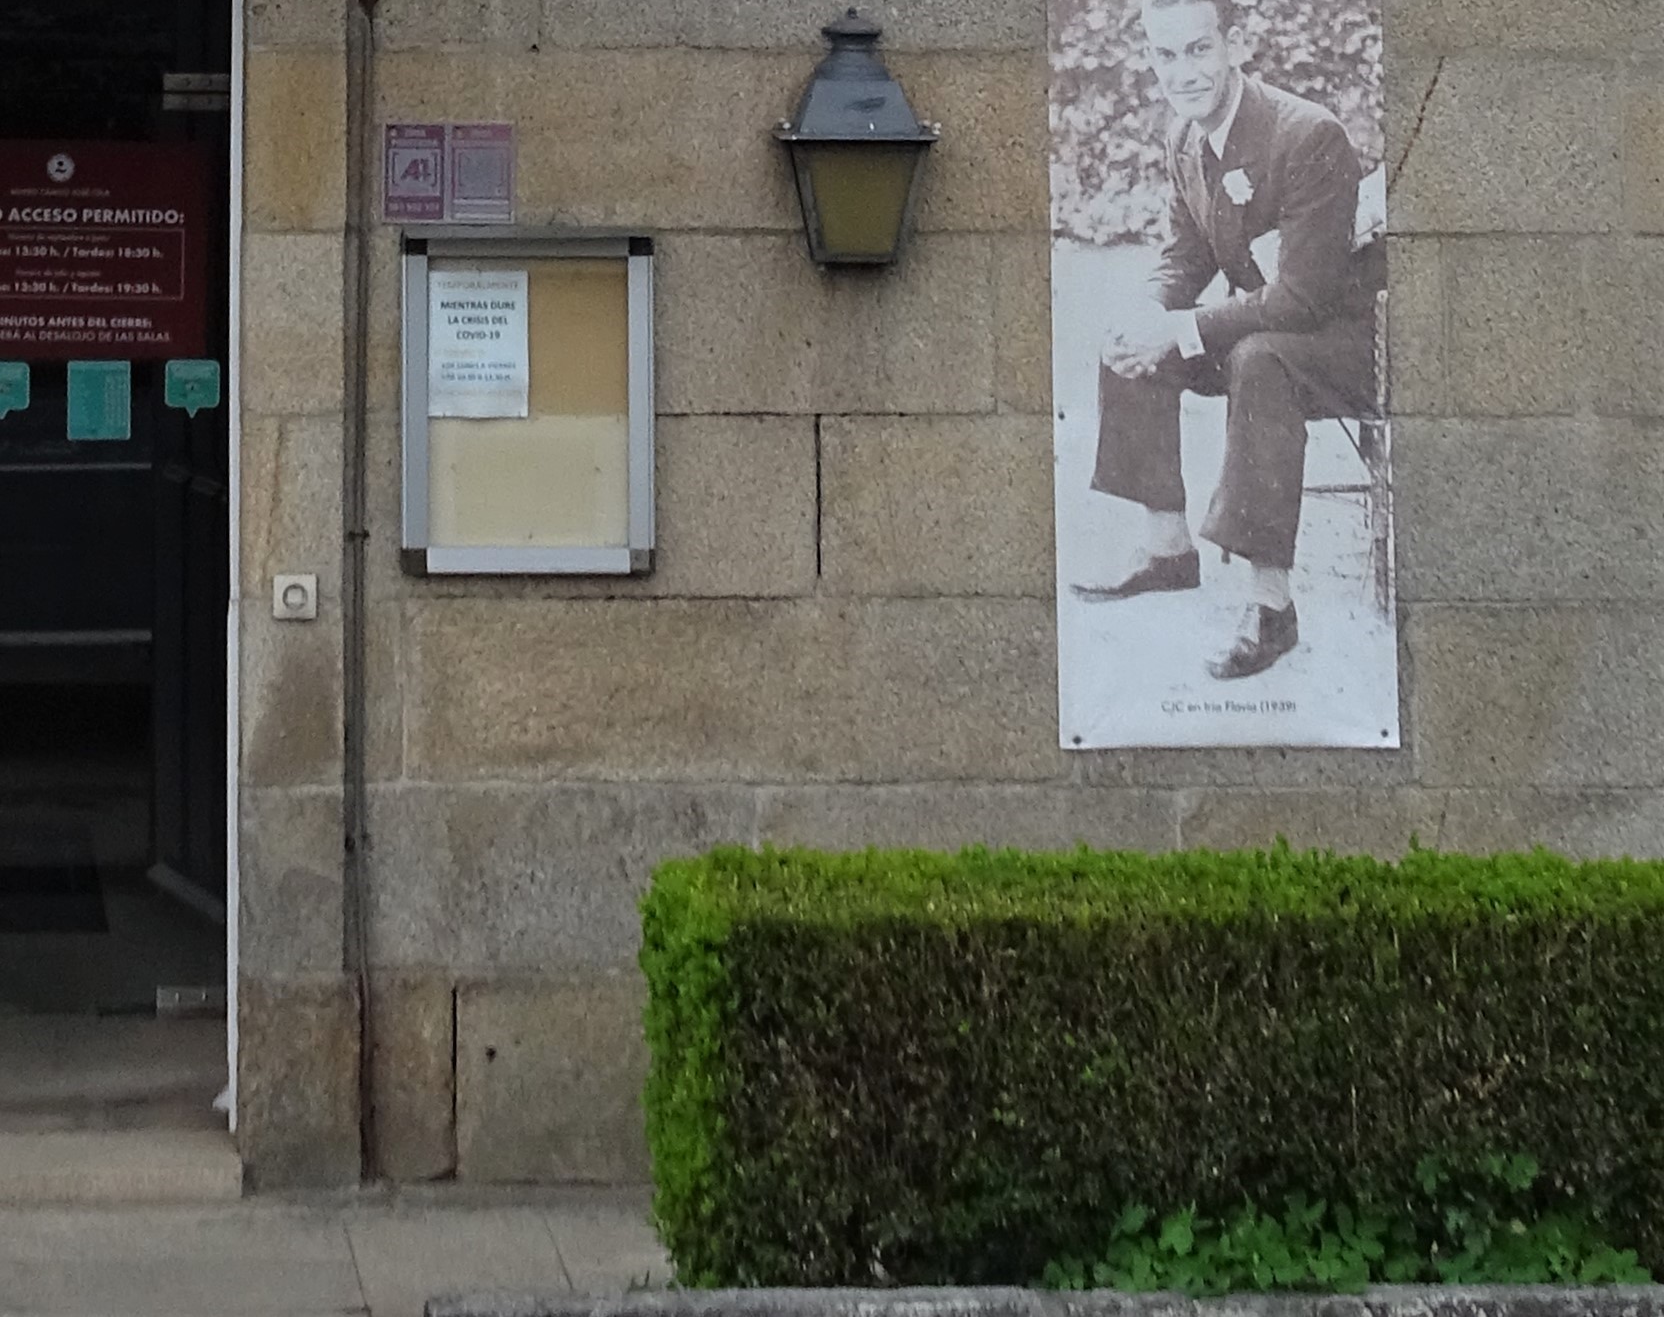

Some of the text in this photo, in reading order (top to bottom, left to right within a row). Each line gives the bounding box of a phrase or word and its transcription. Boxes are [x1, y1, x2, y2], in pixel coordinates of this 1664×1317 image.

[8, 206, 77, 223] ACCESO
[82, 208, 185, 224] PERMITIDO:
[440, 301, 488, 310] MIENTRAS
[48, 317, 85, 327] ANTES
[448, 316, 508, 325] LA CRISIS DEL
[456, 331, 501, 340] COVID-19
